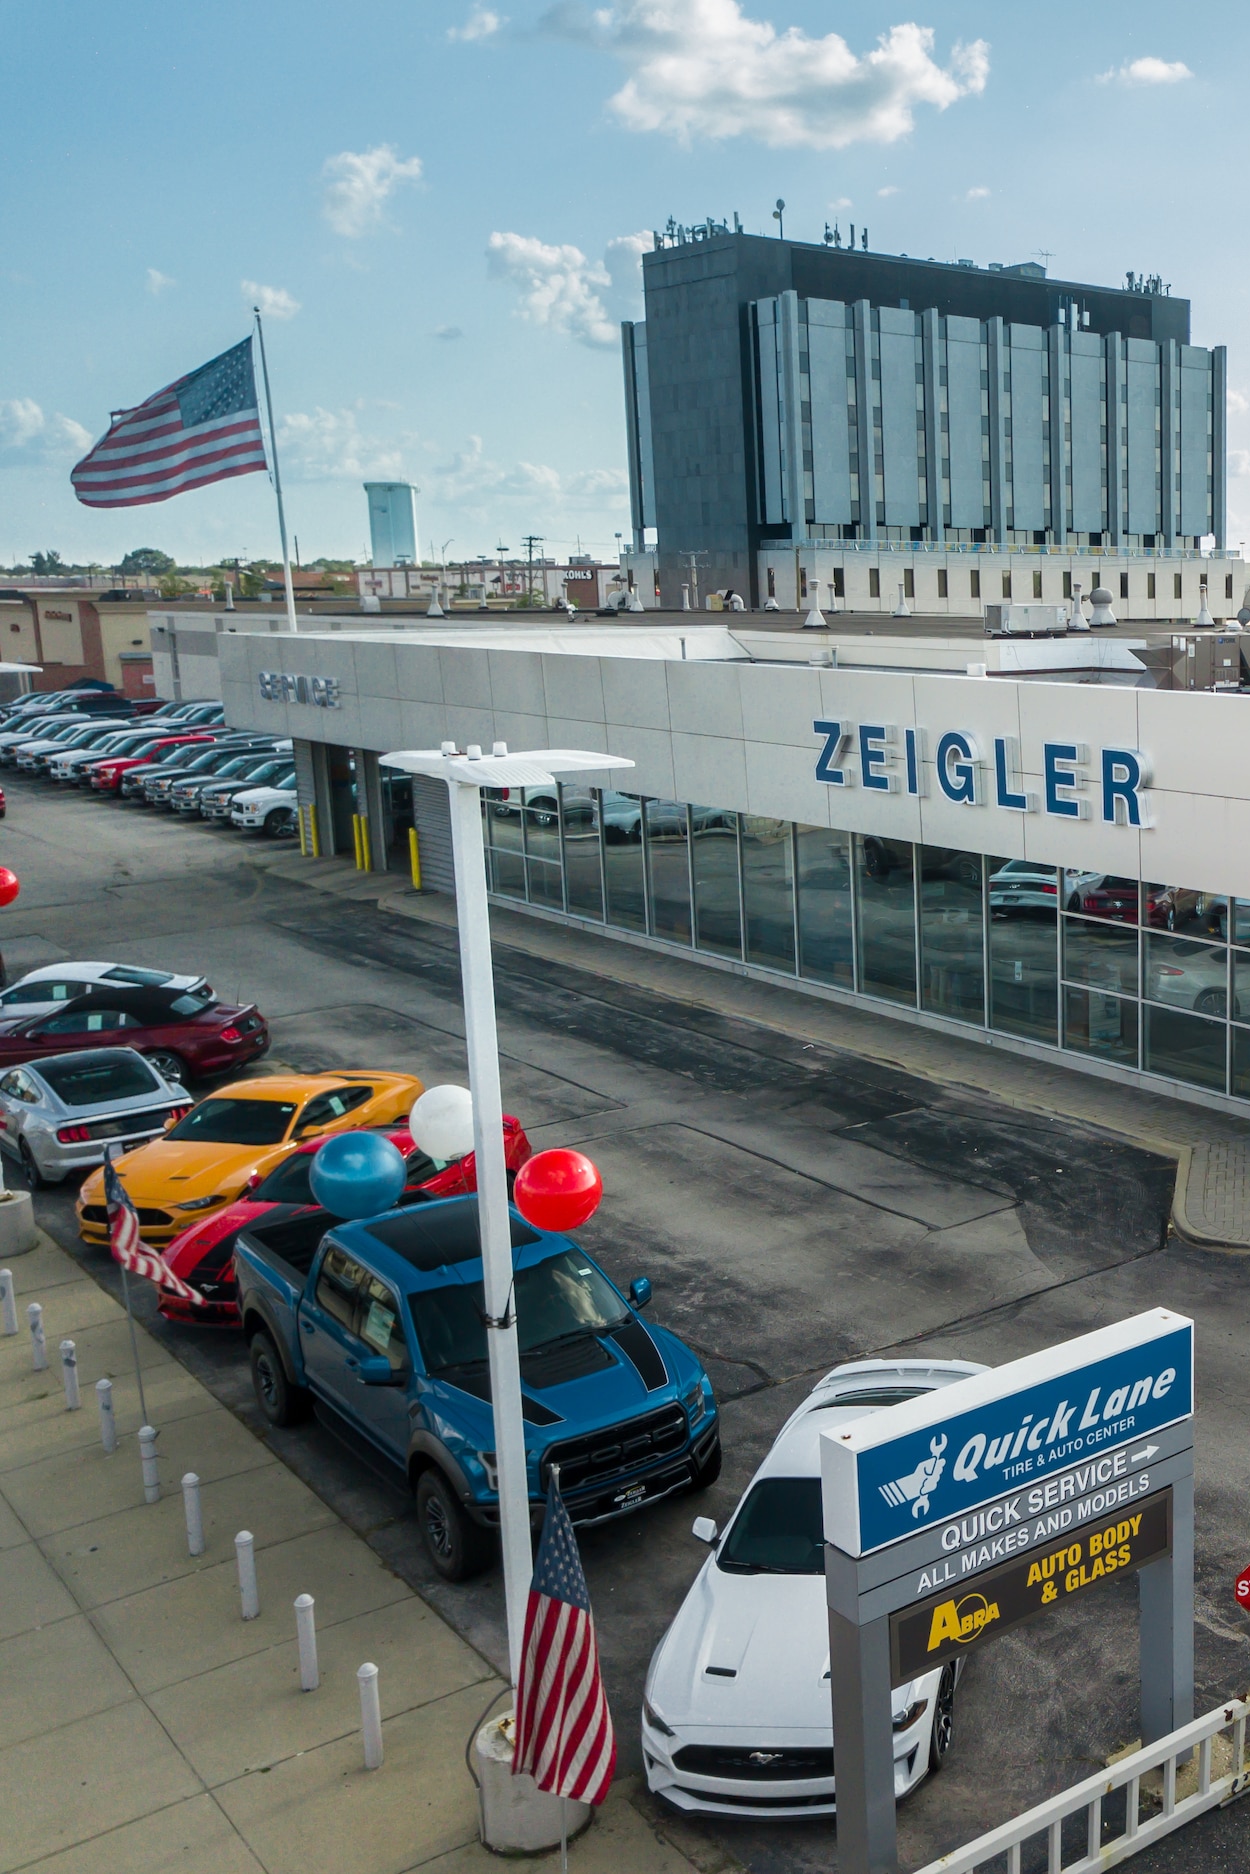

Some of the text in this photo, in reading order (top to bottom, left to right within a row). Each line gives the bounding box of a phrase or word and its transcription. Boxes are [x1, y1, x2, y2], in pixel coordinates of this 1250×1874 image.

[258, 671, 341, 709] SERVICE
[812, 719, 1154, 830] ZEIGLER
[953, 1367, 1176, 1482] Quick Lane
[1002, 1416, 1135, 1480] TIRE & AUTO CENTER
[917, 1474, 1150, 1593] ALL MAKES AND MODELS
[941, 1450, 1127, 1552] QUICK SERVICE
[1026, 1513, 1144, 1587] AUTO BODY
[1041, 1545, 1131, 1604] & GLASS
[927, 1599, 1000, 1652] ABRA
